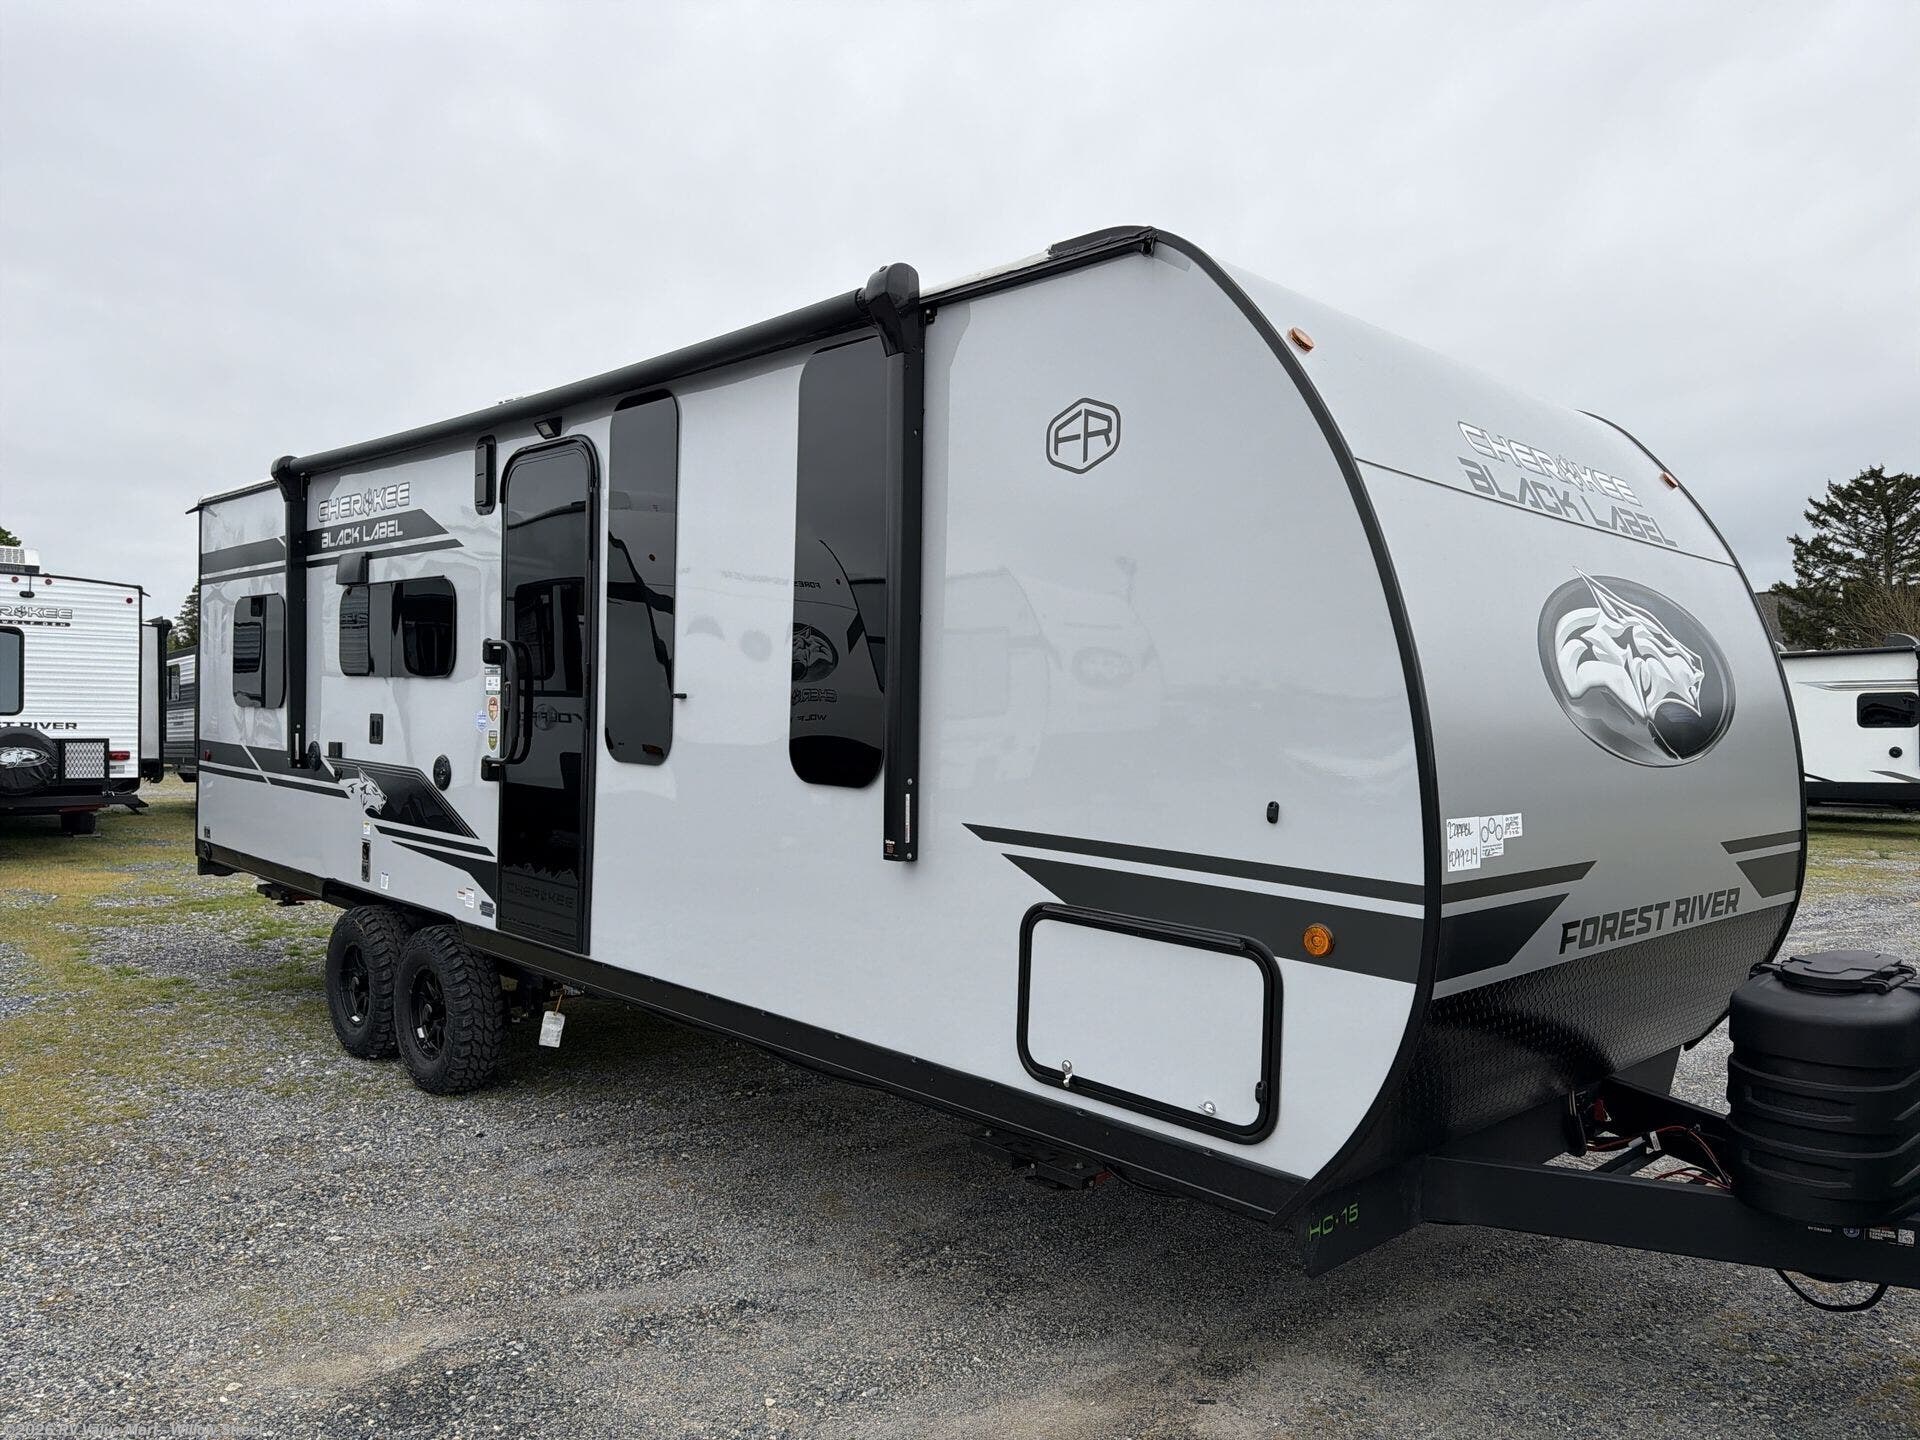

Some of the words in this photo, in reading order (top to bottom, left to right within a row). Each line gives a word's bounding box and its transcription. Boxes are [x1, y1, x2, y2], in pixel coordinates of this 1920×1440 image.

[1457, 420, 1644, 508] CHEROKEE
[317, 481, 411, 523] CHEROKEE
[321, 526, 361, 549] BLACK
[362, 519, 404, 542] LABEL
[1457, 456, 1586, 522] BLACK
[1580, 495, 1679, 548] LABEL
[1558, 900, 1671, 955] FOREST
[1672, 886, 1741, 928] RIVER
